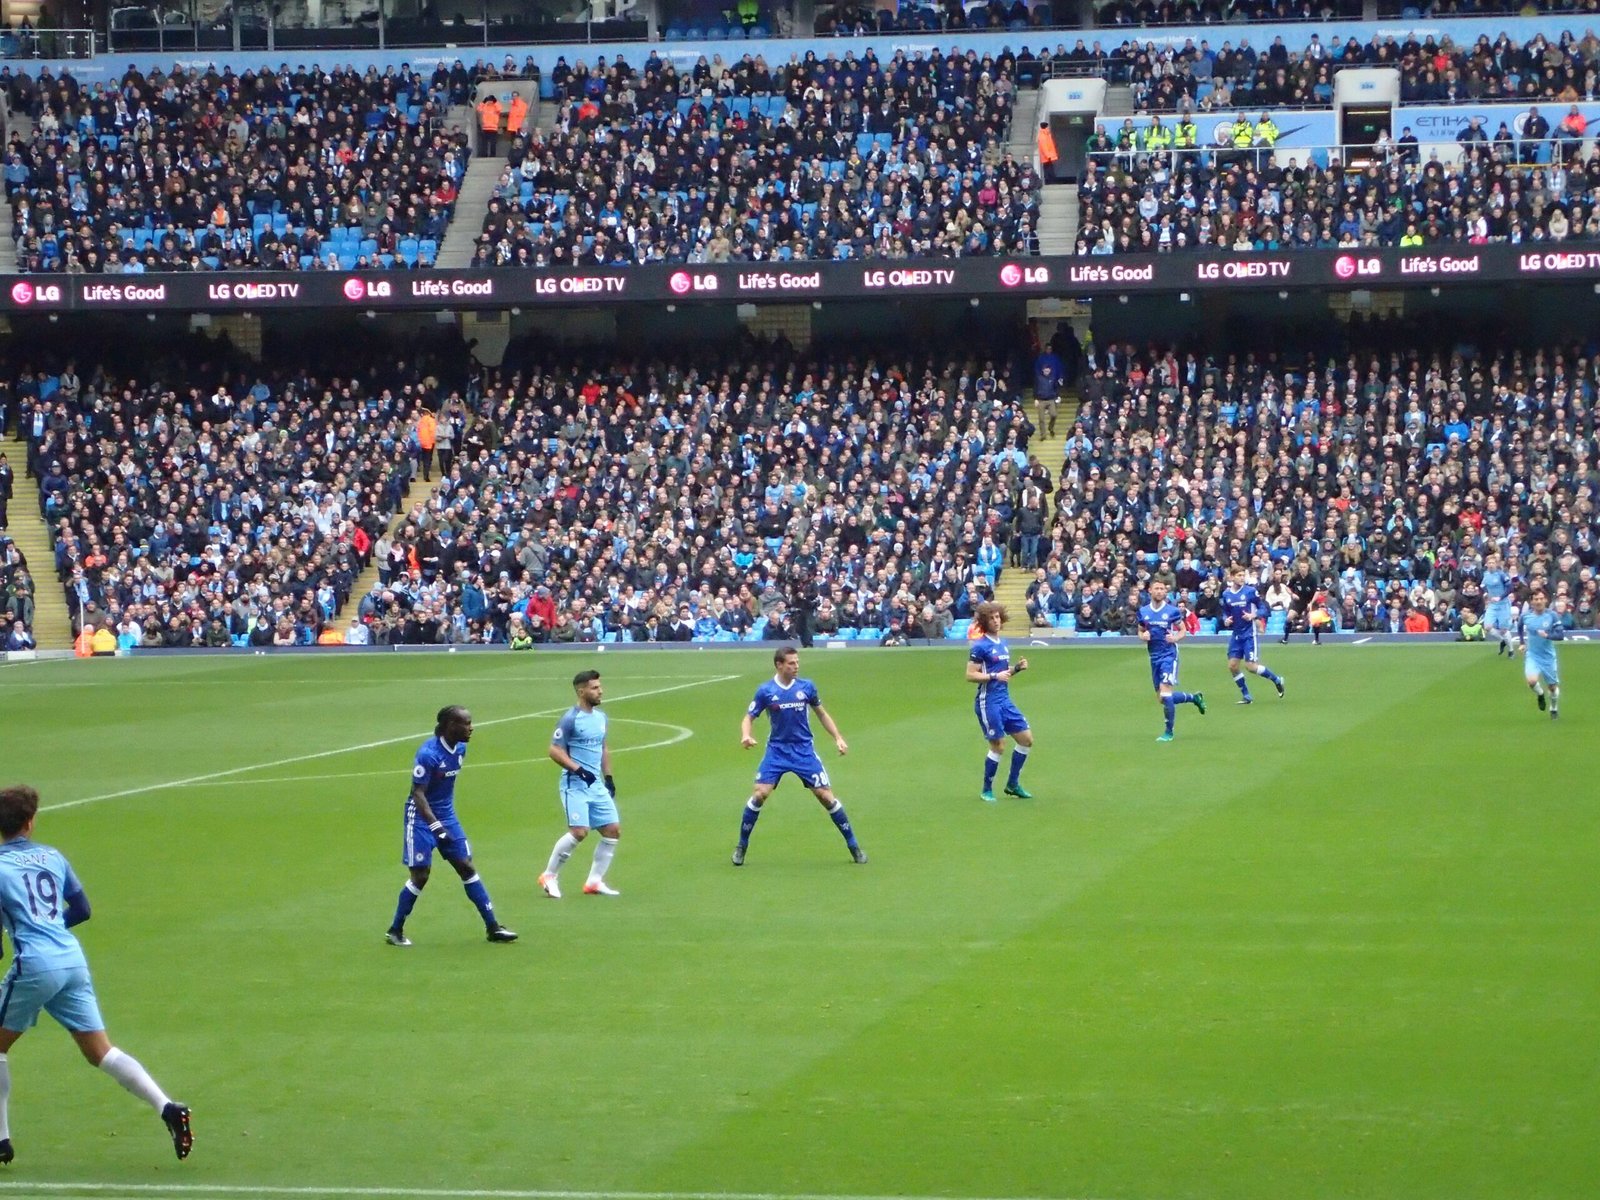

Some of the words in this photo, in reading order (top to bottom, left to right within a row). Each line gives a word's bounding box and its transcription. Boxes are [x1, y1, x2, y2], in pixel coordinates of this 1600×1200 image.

[1416, 114, 1488, 128] ETIHAD
[1197, 262, 1220, 279] LG
[1222, 261, 1267, 279] OLED
[1268, 261, 1291, 277] TV
[1357, 258, 1381, 274] LG
[1400, 256, 1438, 274] Life's
[1438, 255, 1479, 273] Good
[1520, 254, 1541, 270] LG
[1543, 253, 1587, 270] OLED
[738, 272, 777, 290] Life's
[779, 271, 820, 289] Good
[864, 270, 886, 287] LG
[888, 269, 932, 287] OLED
[933, 269, 955, 285] TV
[1023, 266, 1049, 284] LG
[1070, 265, 1110, 282] Life's
[1111, 264, 1153, 282] Good
[208, 283, 231, 300] LG
[233, 283, 277, 299] OLED
[278, 283, 299, 298] TV
[366, 281, 391, 298] LG
[412, 279, 450, 296] Life's
[451, 278, 493, 296] Good
[535, 277, 558, 294] LG
[559, 276, 603, 294] OLED
[604, 276, 626, 292] TV
[693, 274, 718, 291] LG
[36, 286, 60, 302] LG
[83, 284, 122, 301] Life's
[124, 284, 166, 301] Good
[21, 870, 58, 921] 19
